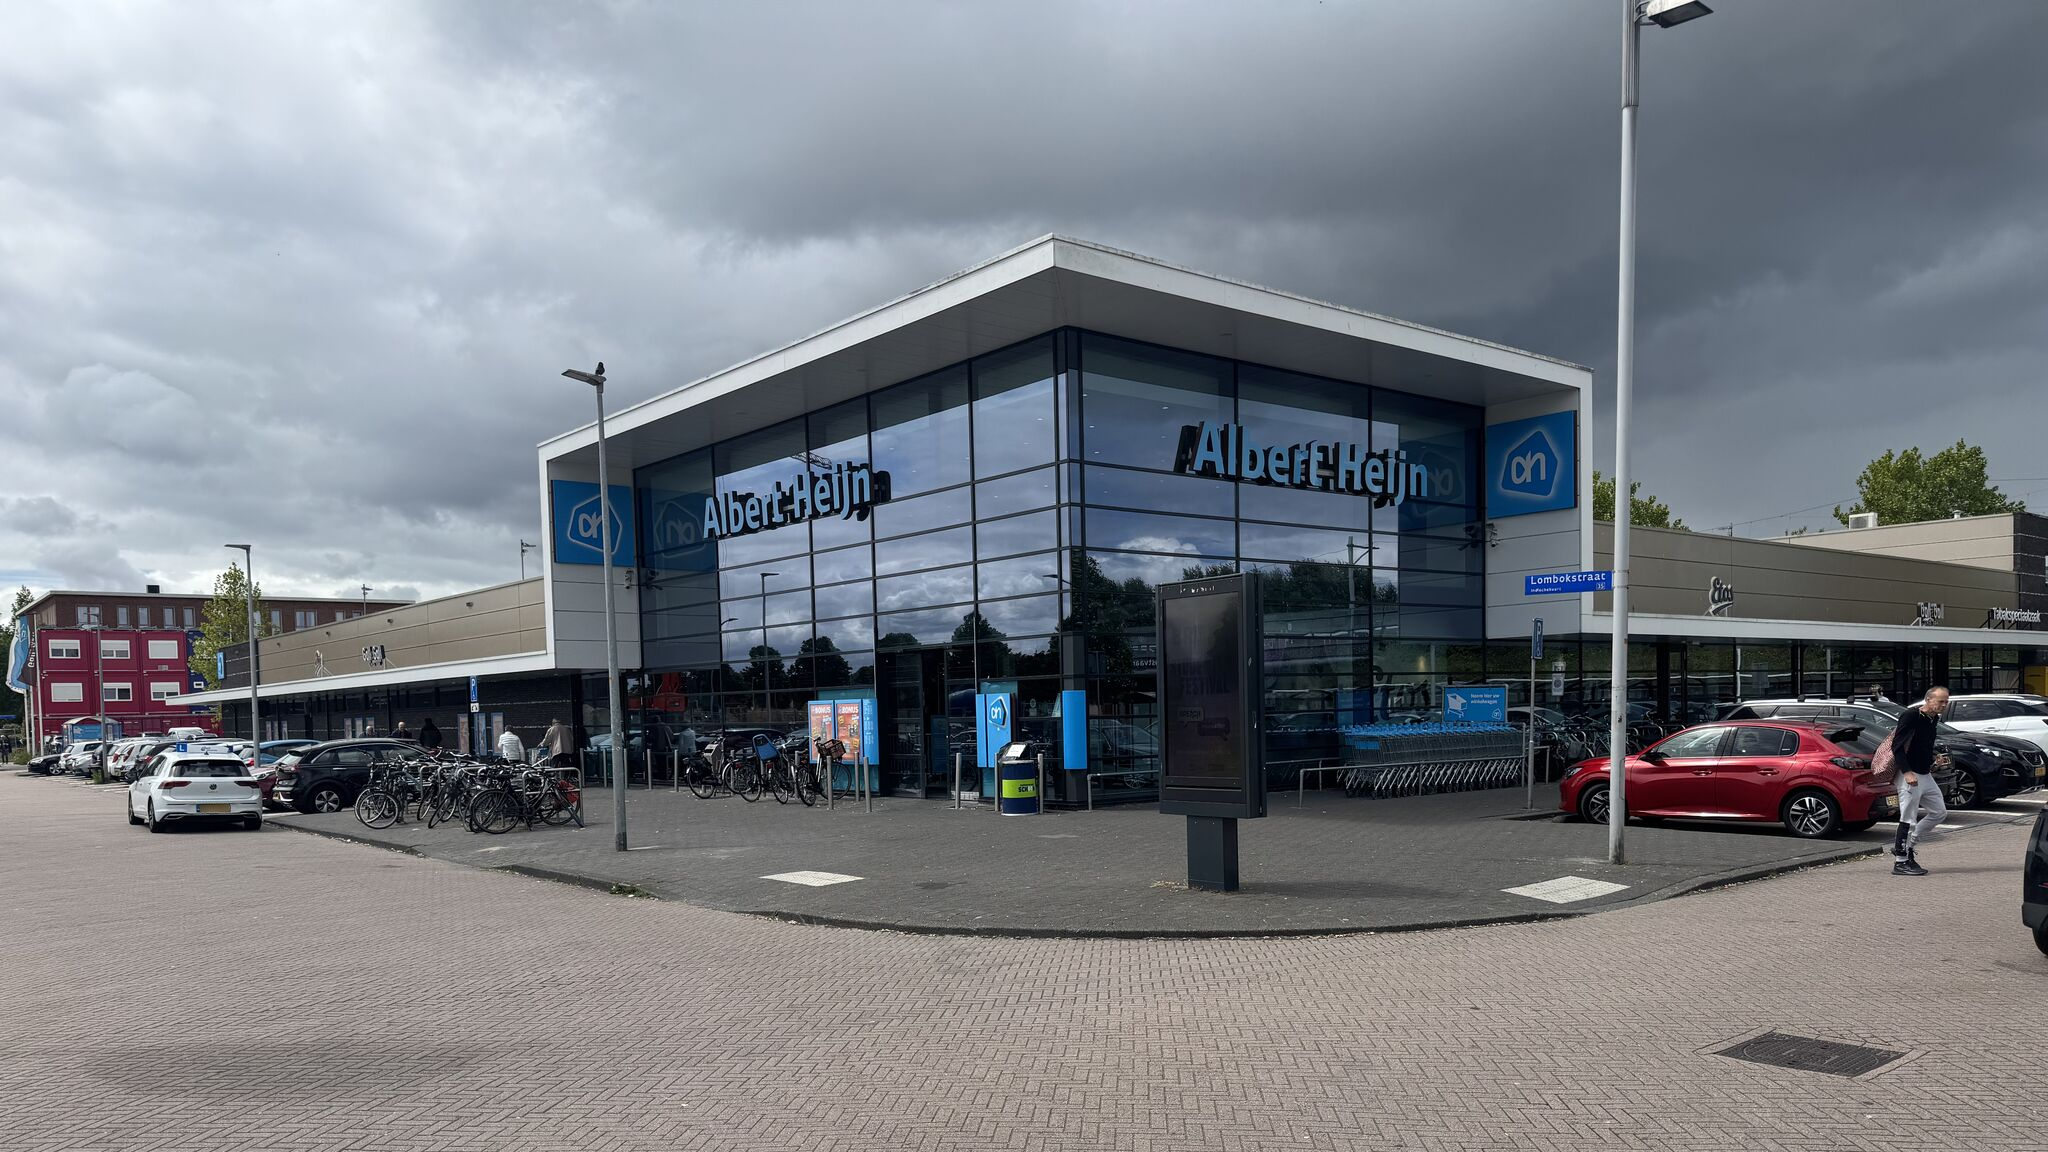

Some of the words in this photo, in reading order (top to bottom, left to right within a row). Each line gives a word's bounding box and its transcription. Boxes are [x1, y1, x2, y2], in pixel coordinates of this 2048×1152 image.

[1194, 421, 1323, 488] Albert
[1338, 442, 1428, 505] Heijn
[704, 485, 784, 539] Albert
[793, 466, 871, 520] Heijn
[1530, 573, 1606, 585] Lombokstraat
